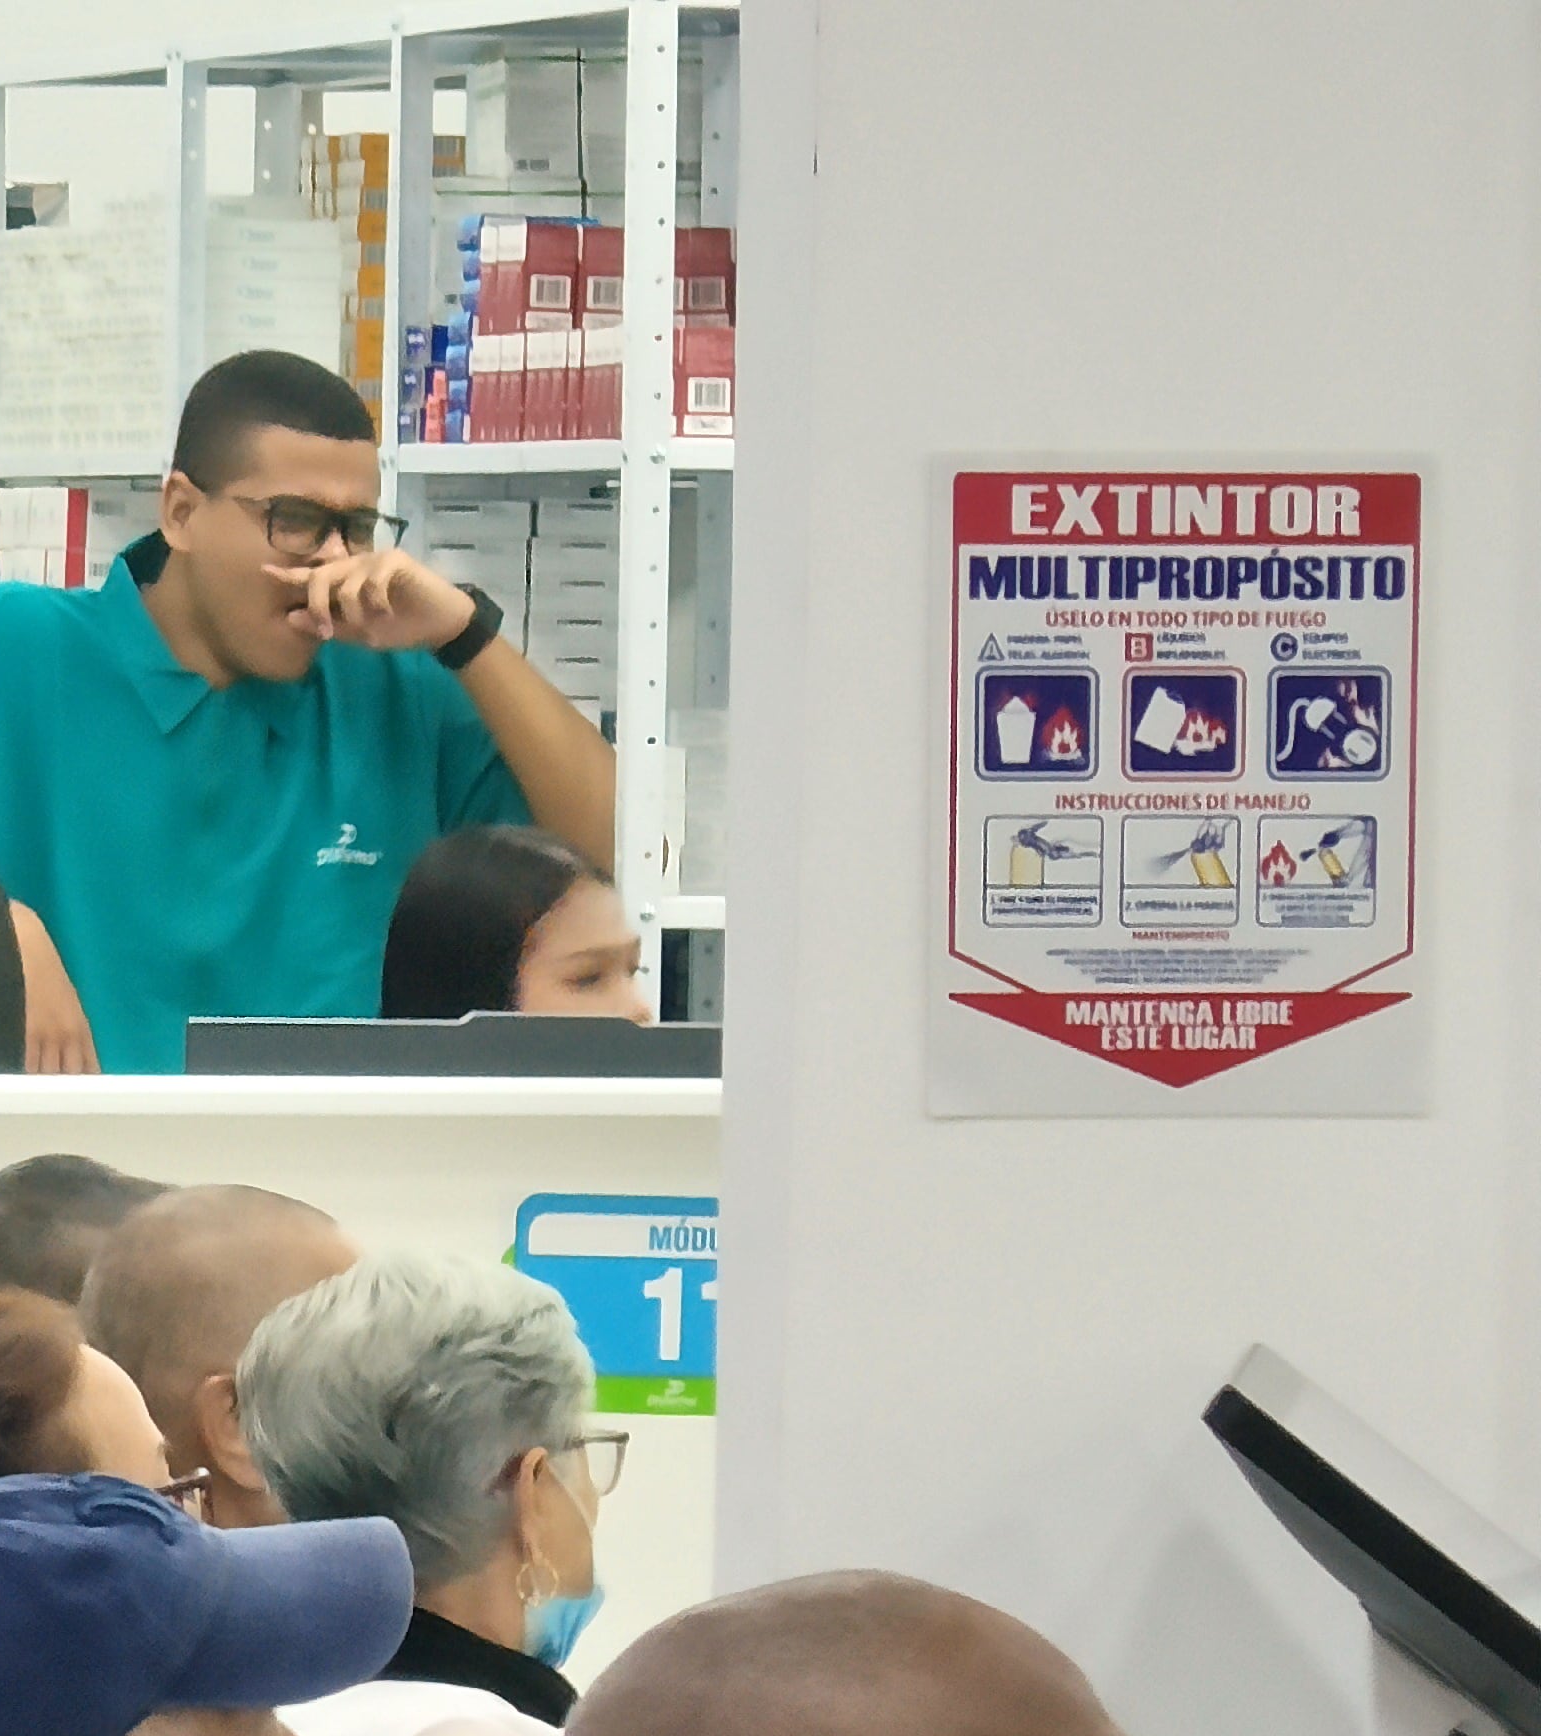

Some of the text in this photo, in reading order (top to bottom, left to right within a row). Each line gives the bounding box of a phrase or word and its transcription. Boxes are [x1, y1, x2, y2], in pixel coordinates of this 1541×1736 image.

[1011, 484, 1362, 537] EXTINTOR
[969, 548, 1406, 601] MULTIPROPÓSITO
[1108, 611, 1133, 627] EN
[1136, 611, 1188, 628] TODO
[1193, 611, 1234, 628] TIPO
[1237, 611, 1261, 628] DE
[1265, 611, 1327, 628] FUEGO
[1131, 638, 1148, 657] B
[1276, 637, 1295, 656] C
[1055, 793, 1311, 811] INSTRUCCIONES DE MANEJO
[1065, 1000, 1294, 1025] MANTENGA LIBRE
[1101, 1025, 1257, 1050] ESTE LUGAR
